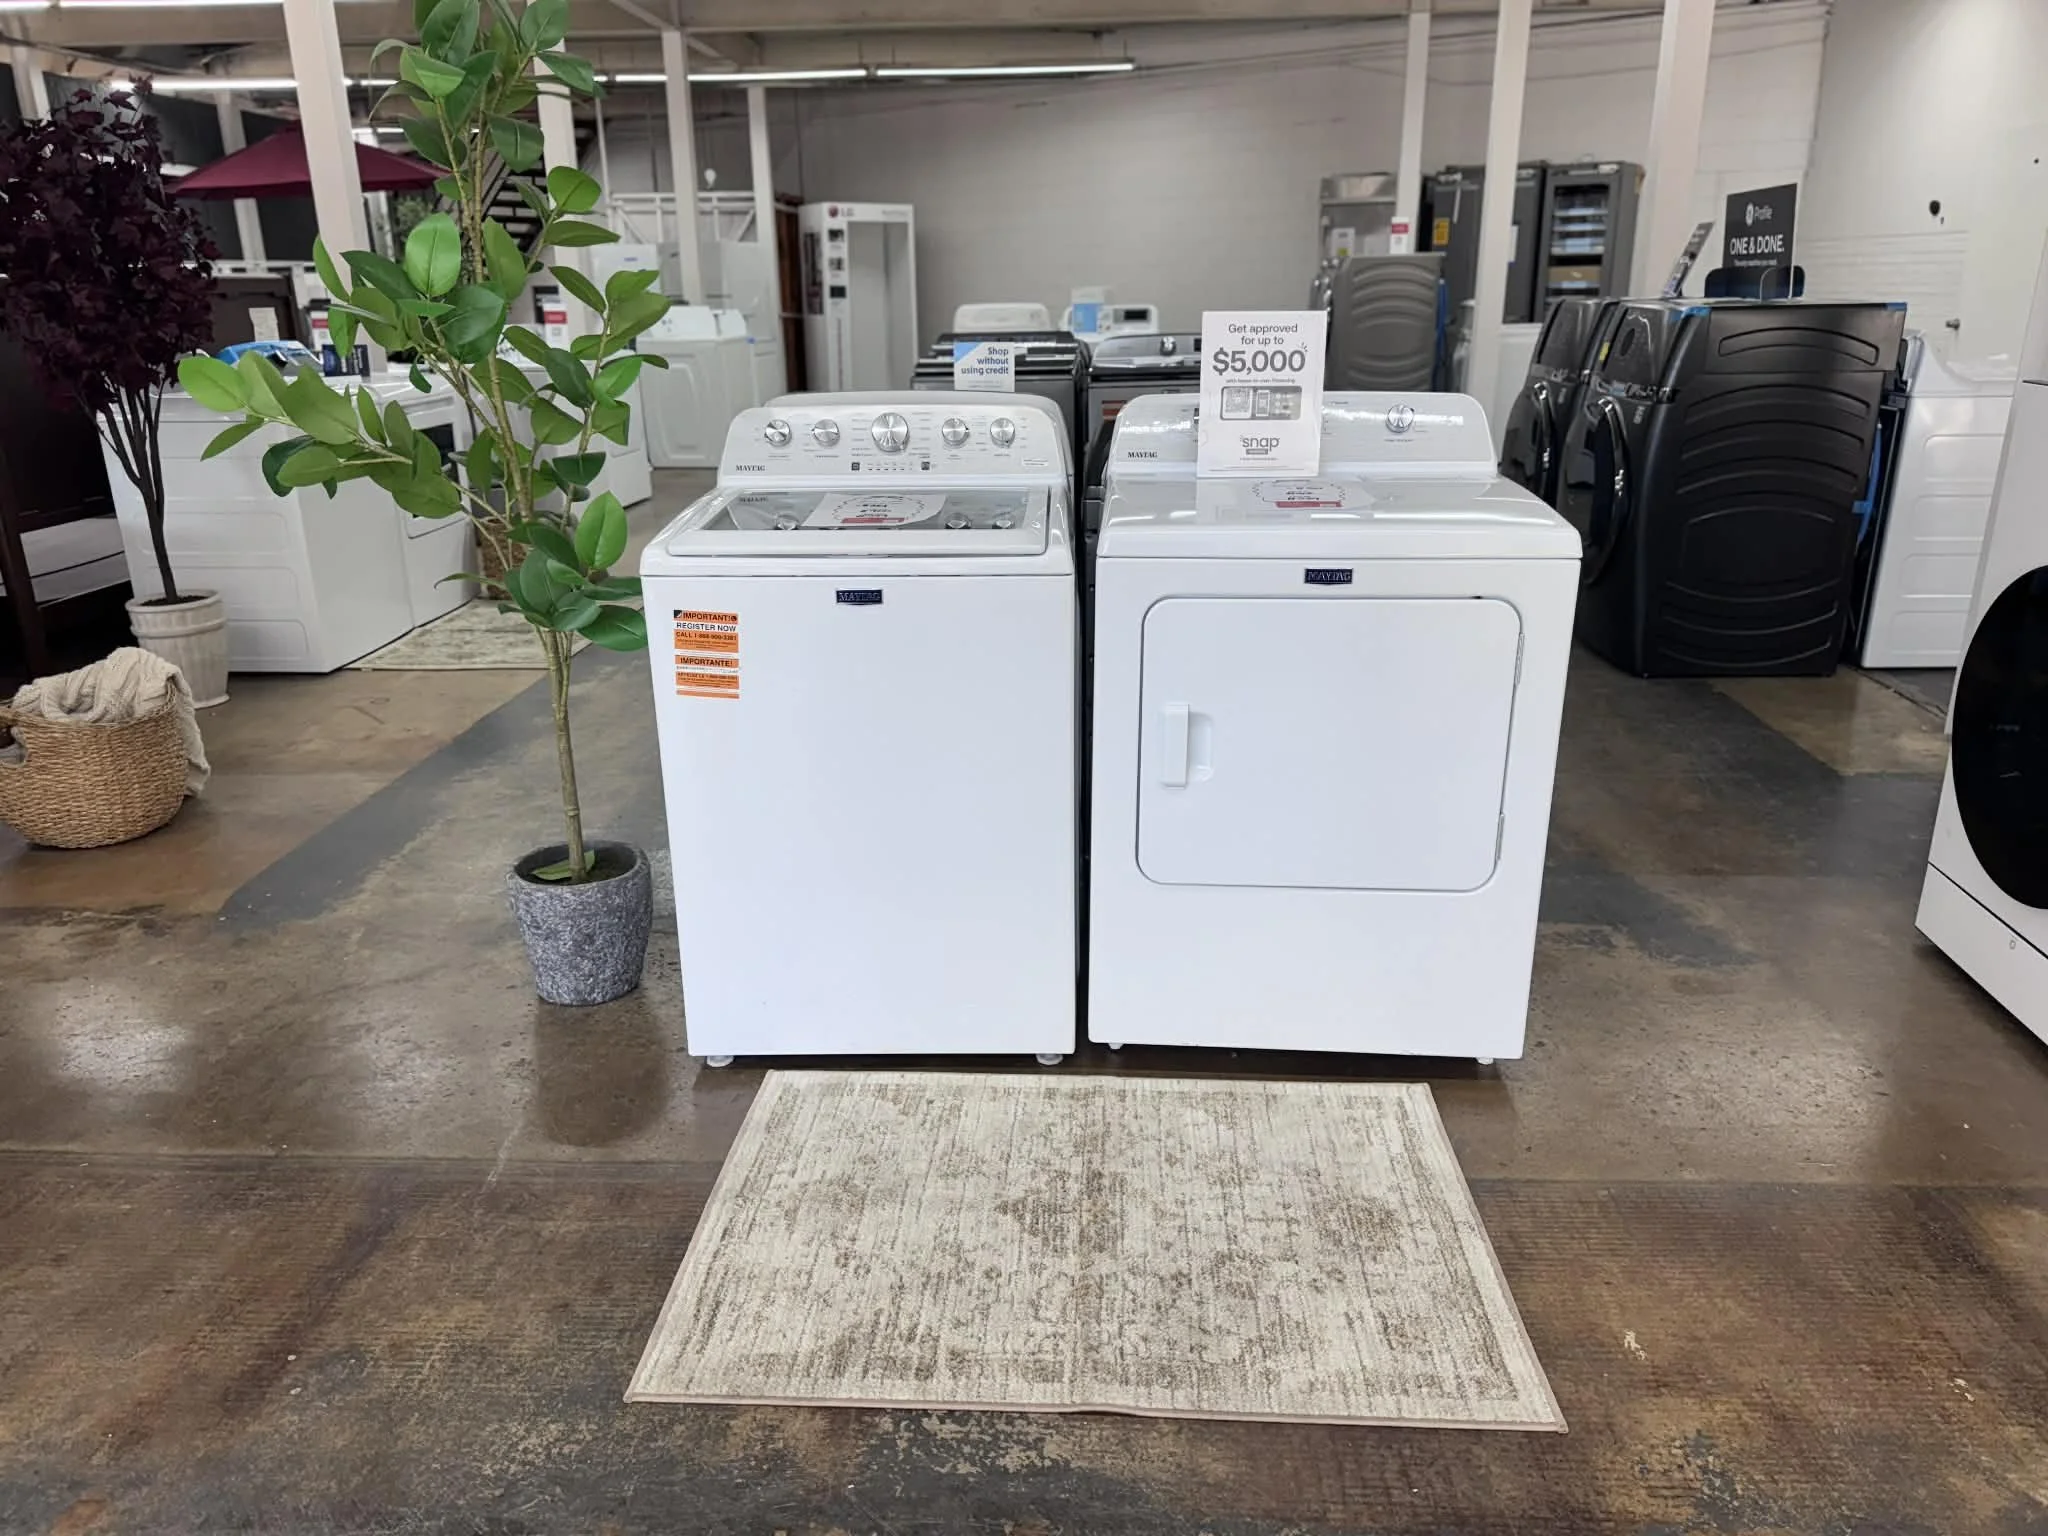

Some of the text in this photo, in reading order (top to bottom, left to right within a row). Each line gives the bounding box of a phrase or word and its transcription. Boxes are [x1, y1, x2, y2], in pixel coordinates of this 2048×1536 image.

[1729, 234, 1785, 256] ONE & DONE.
[1228, 323, 1298, 335] Get approved
[1241, 335, 1284, 347] for up to
[987, 346, 1009, 356] Shop
[976, 356, 1009, 365] without
[1212, 347, 1306, 376] $5,000
[961, 366, 1009, 376] using credit
[676, 622, 737, 632] REGISTER NOW
[676, 631, 693, 639] CALL
